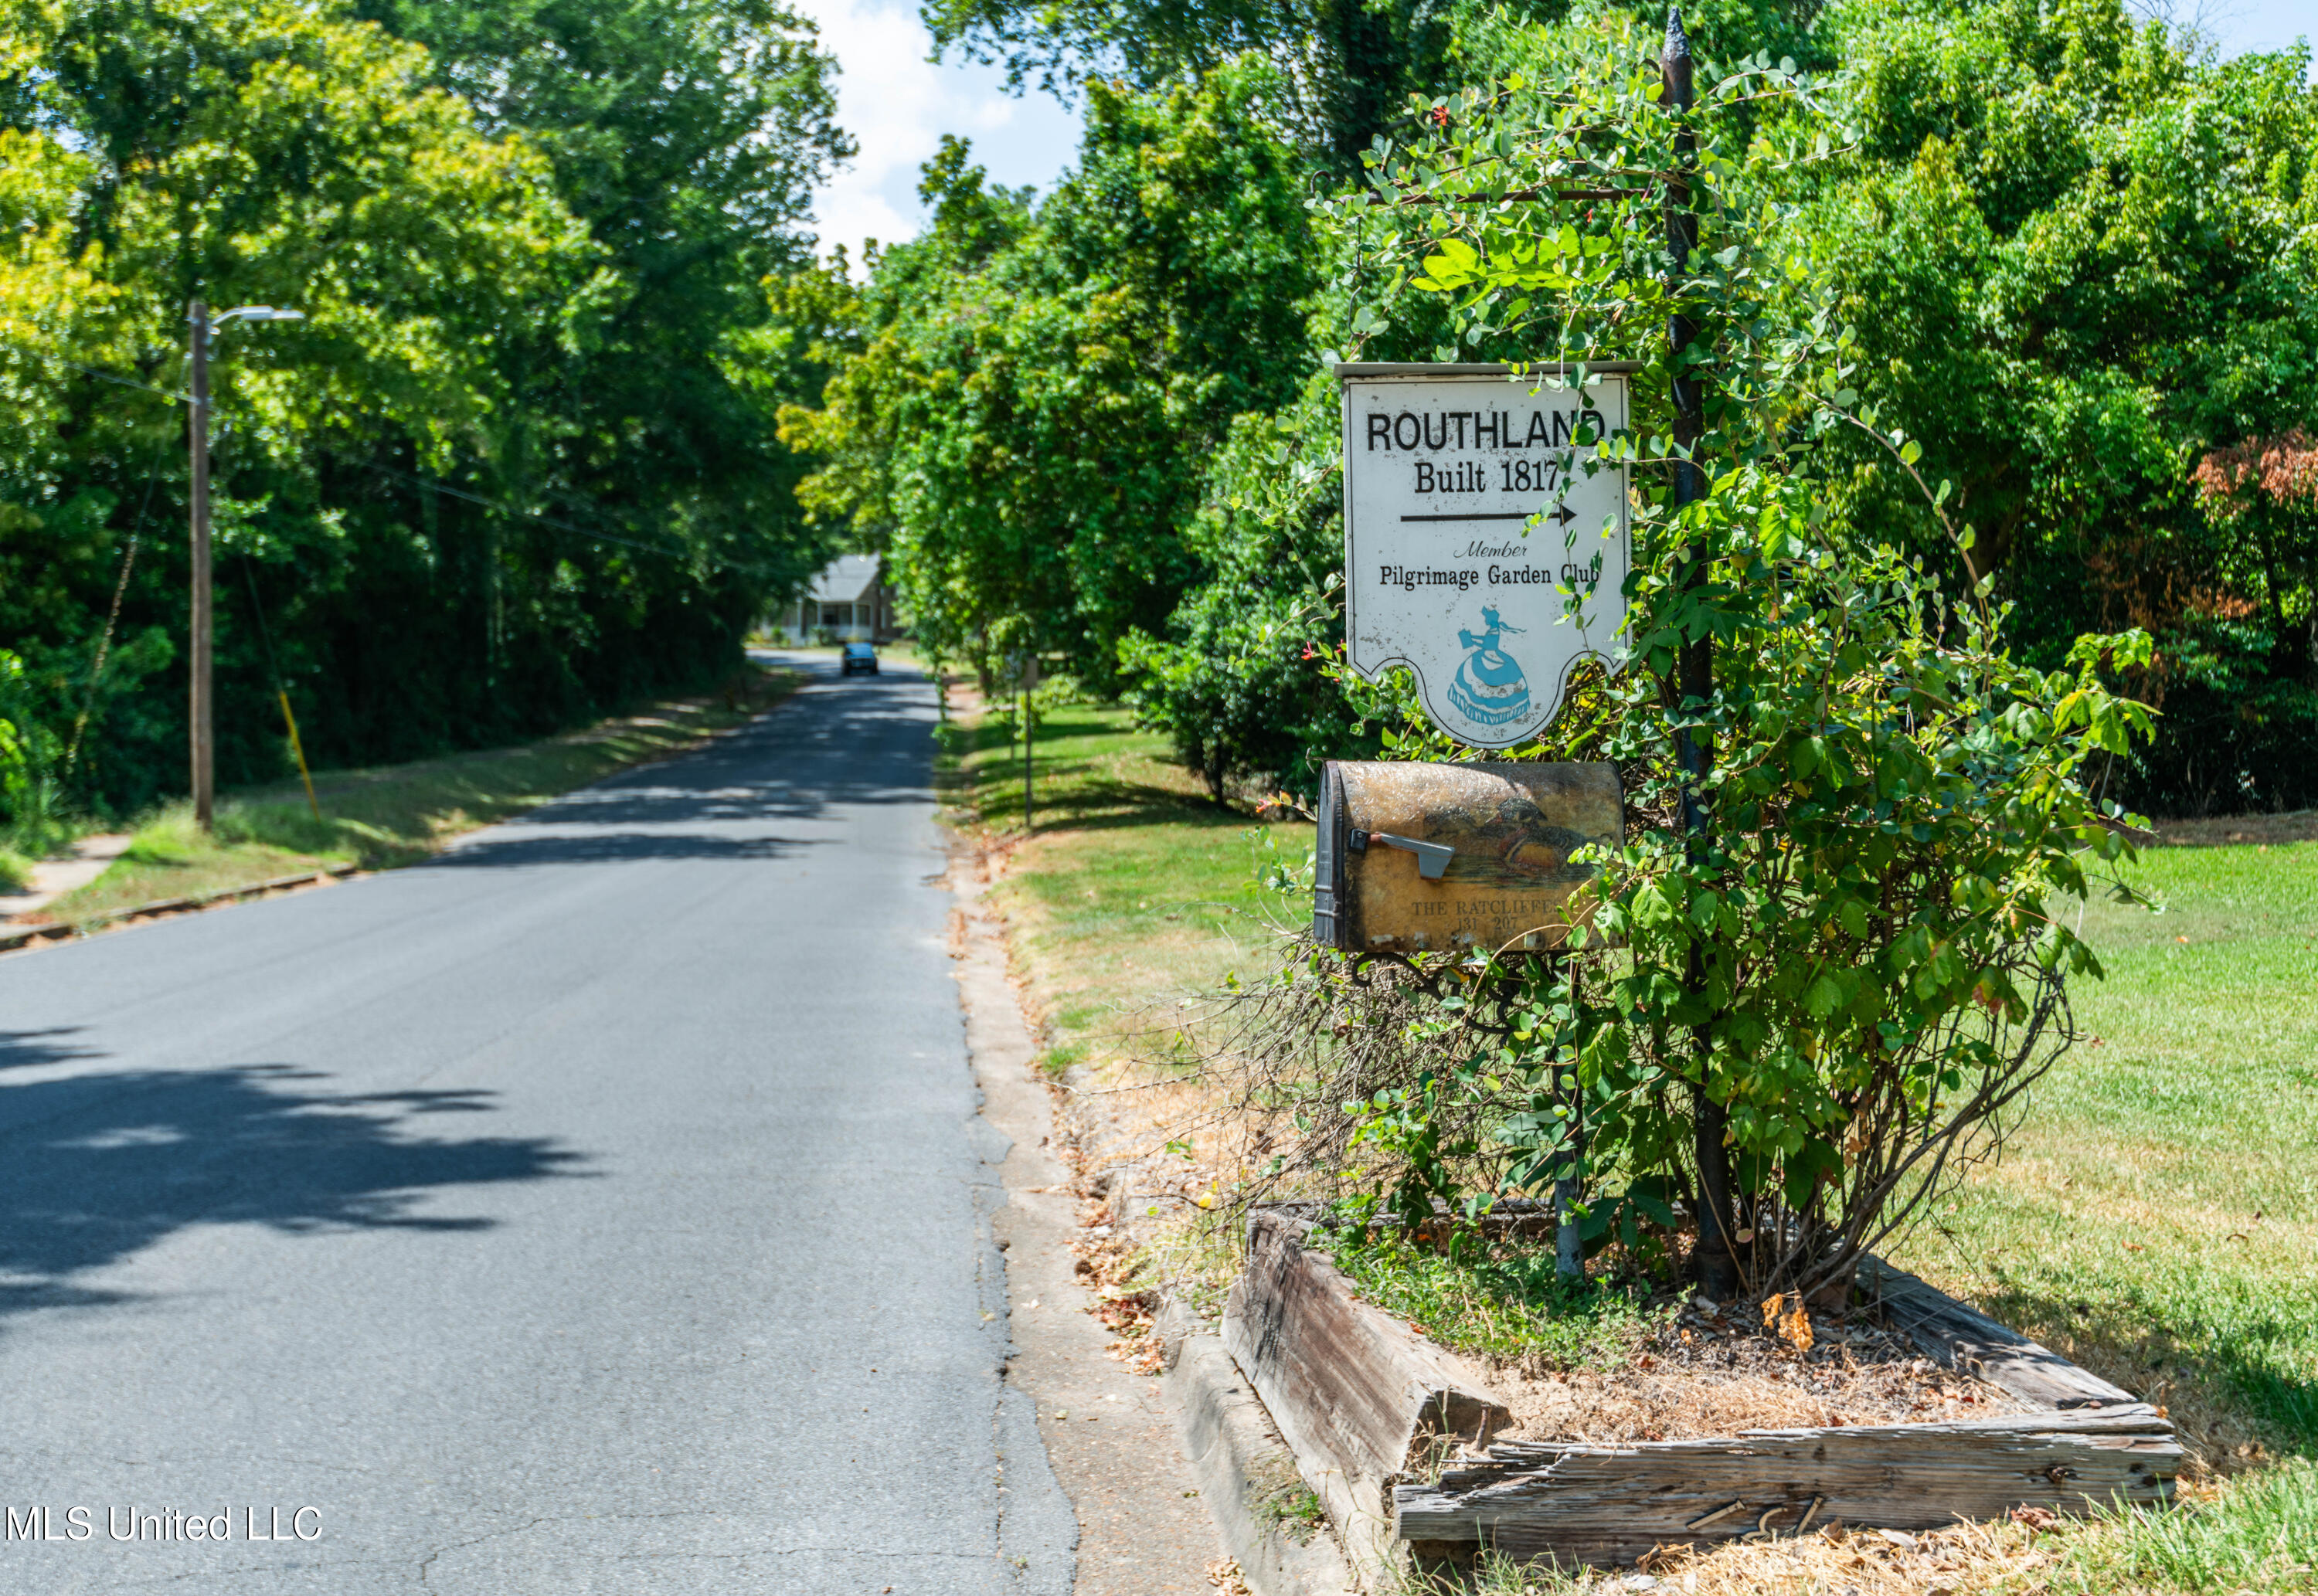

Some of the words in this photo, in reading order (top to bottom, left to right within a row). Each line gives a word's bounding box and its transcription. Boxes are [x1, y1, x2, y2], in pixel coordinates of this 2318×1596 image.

[1368, 409, 1606, 451] ROUTHLAND
[1414, 461, 1487, 494] Built
[1501, 460, 1559, 493] 1817
[1453, 540, 1528, 559] Member
[1379, 565, 1479, 592] Pilgrimage
[1488, 564, 1552, 584] Garden
[1561, 563, 1599, 584] Club
[1412, 901, 1447, 916] THE
